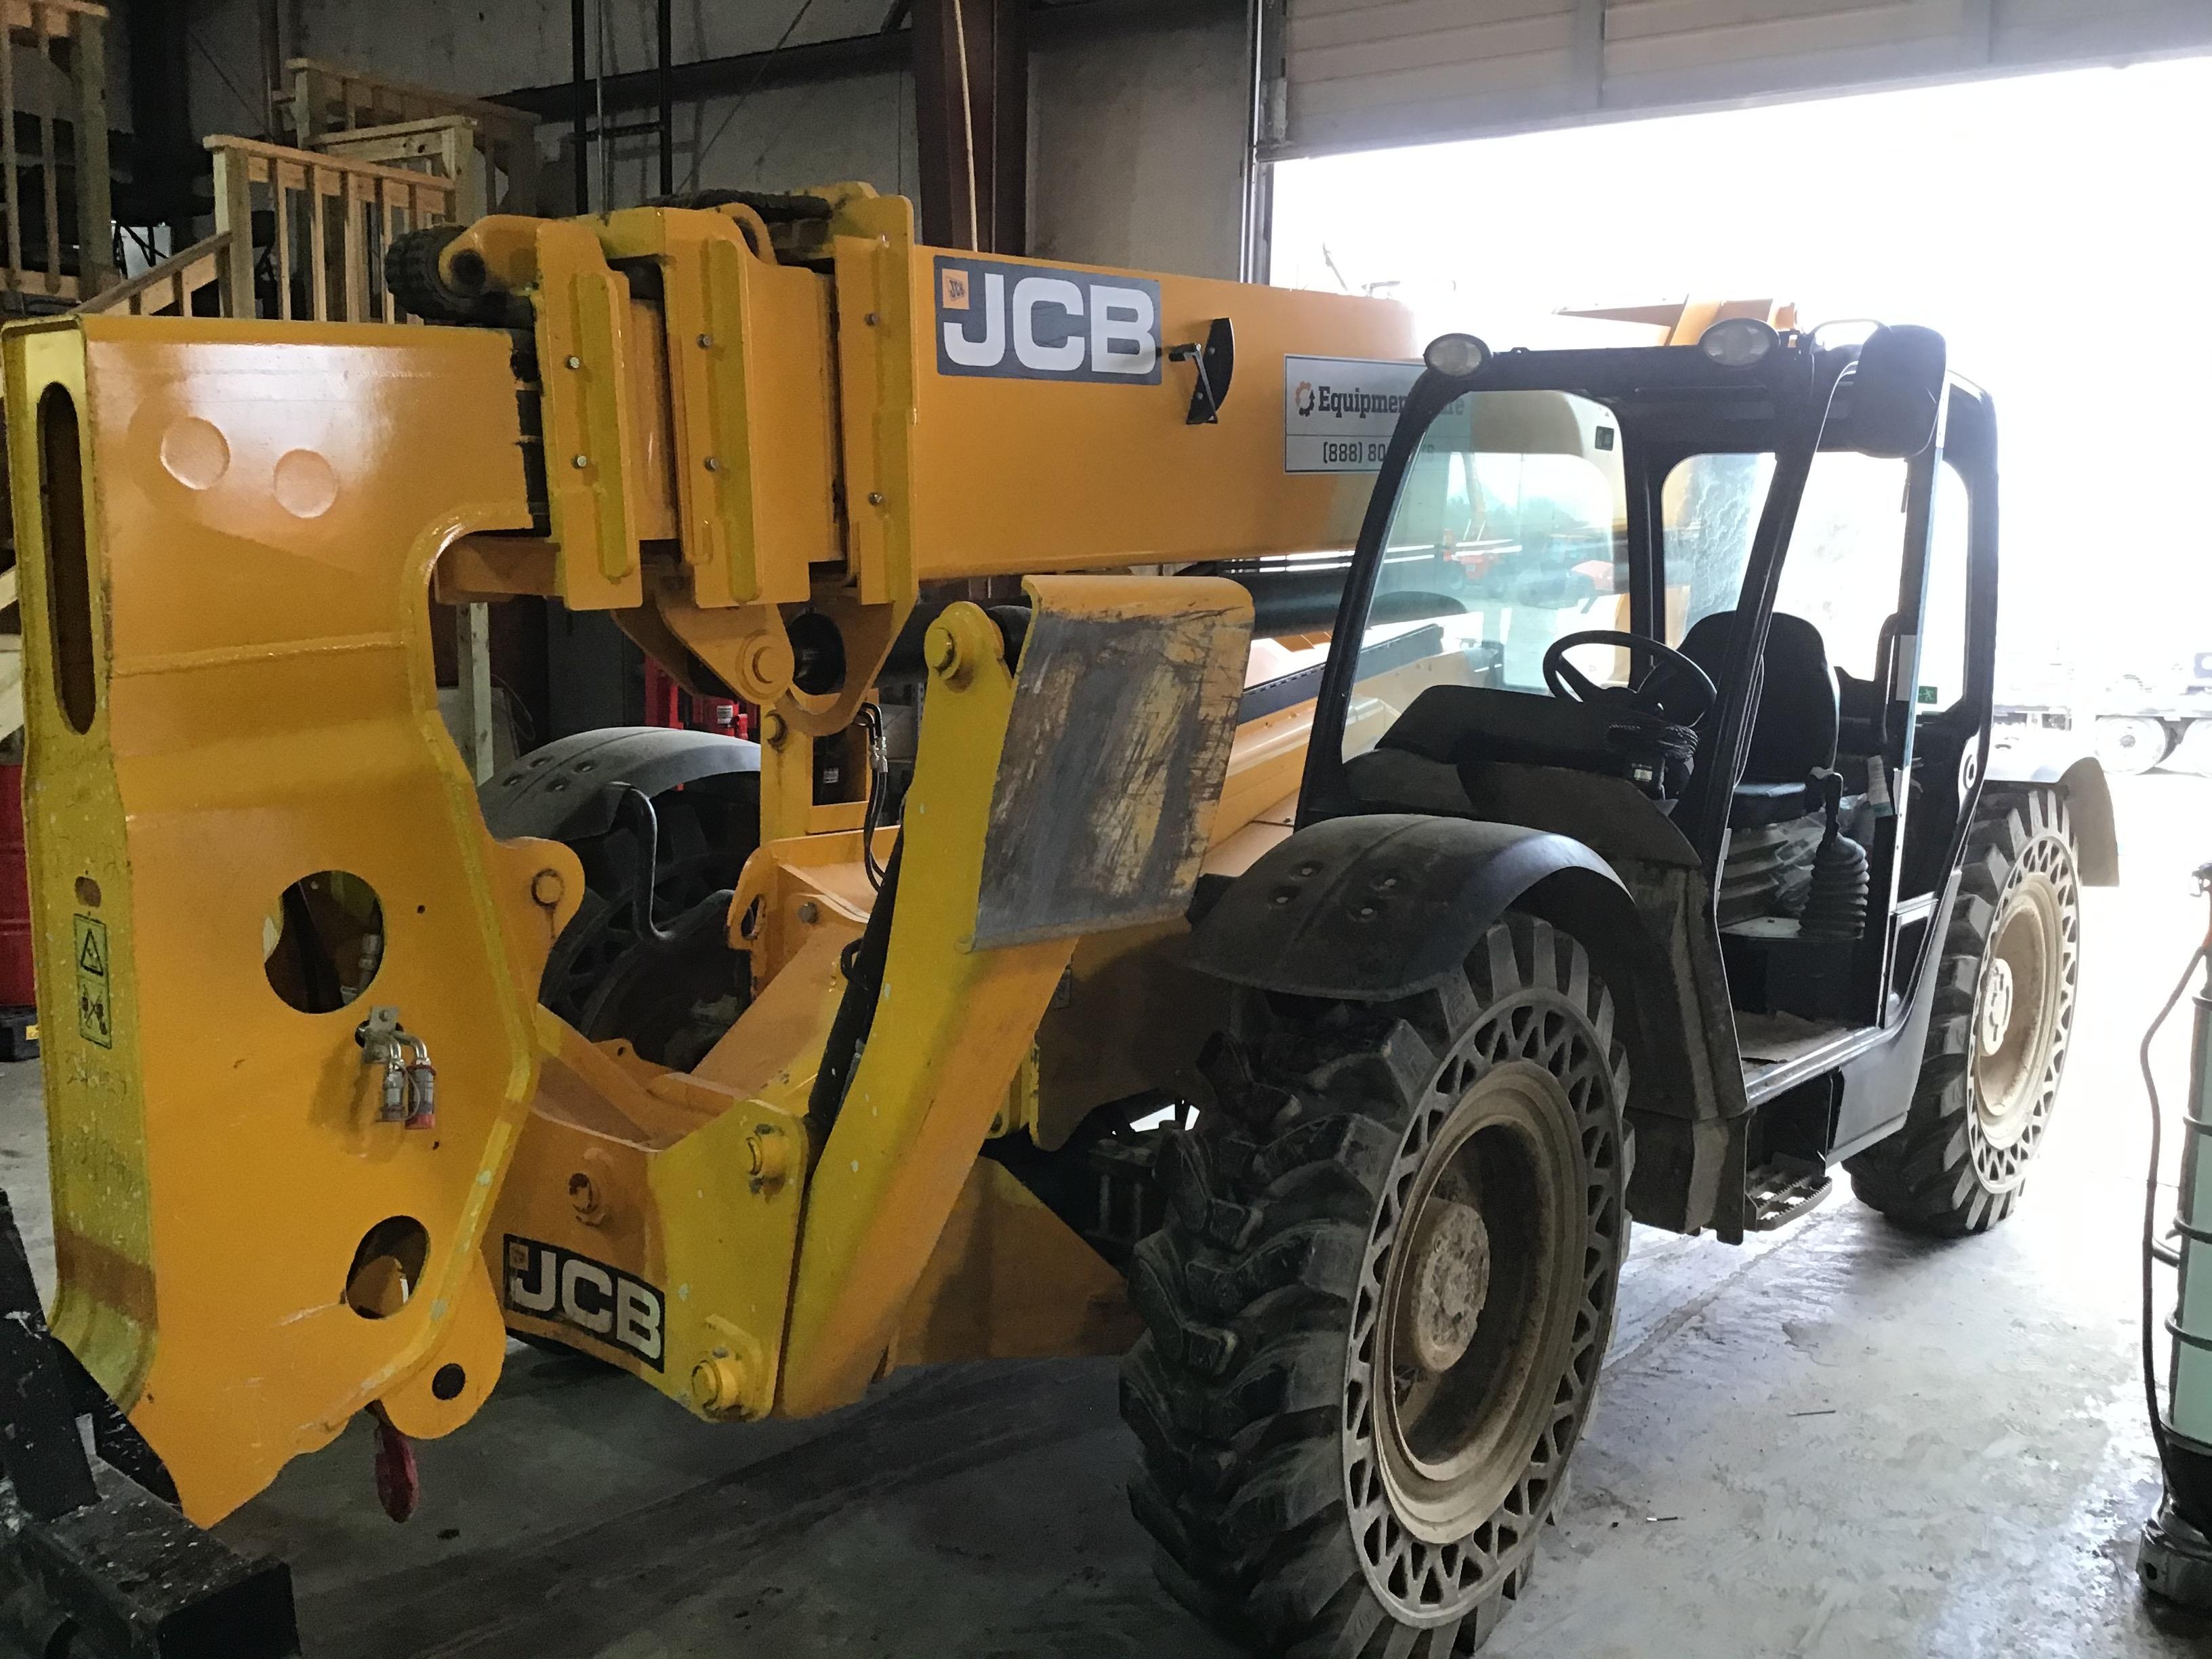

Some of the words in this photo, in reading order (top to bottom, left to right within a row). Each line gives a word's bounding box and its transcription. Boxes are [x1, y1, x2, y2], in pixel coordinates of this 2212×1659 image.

[943, 272, 1156, 375] JCB
[1324, 442, 1362, 464] (888)
[510, 1250, 661, 1359] JCB
